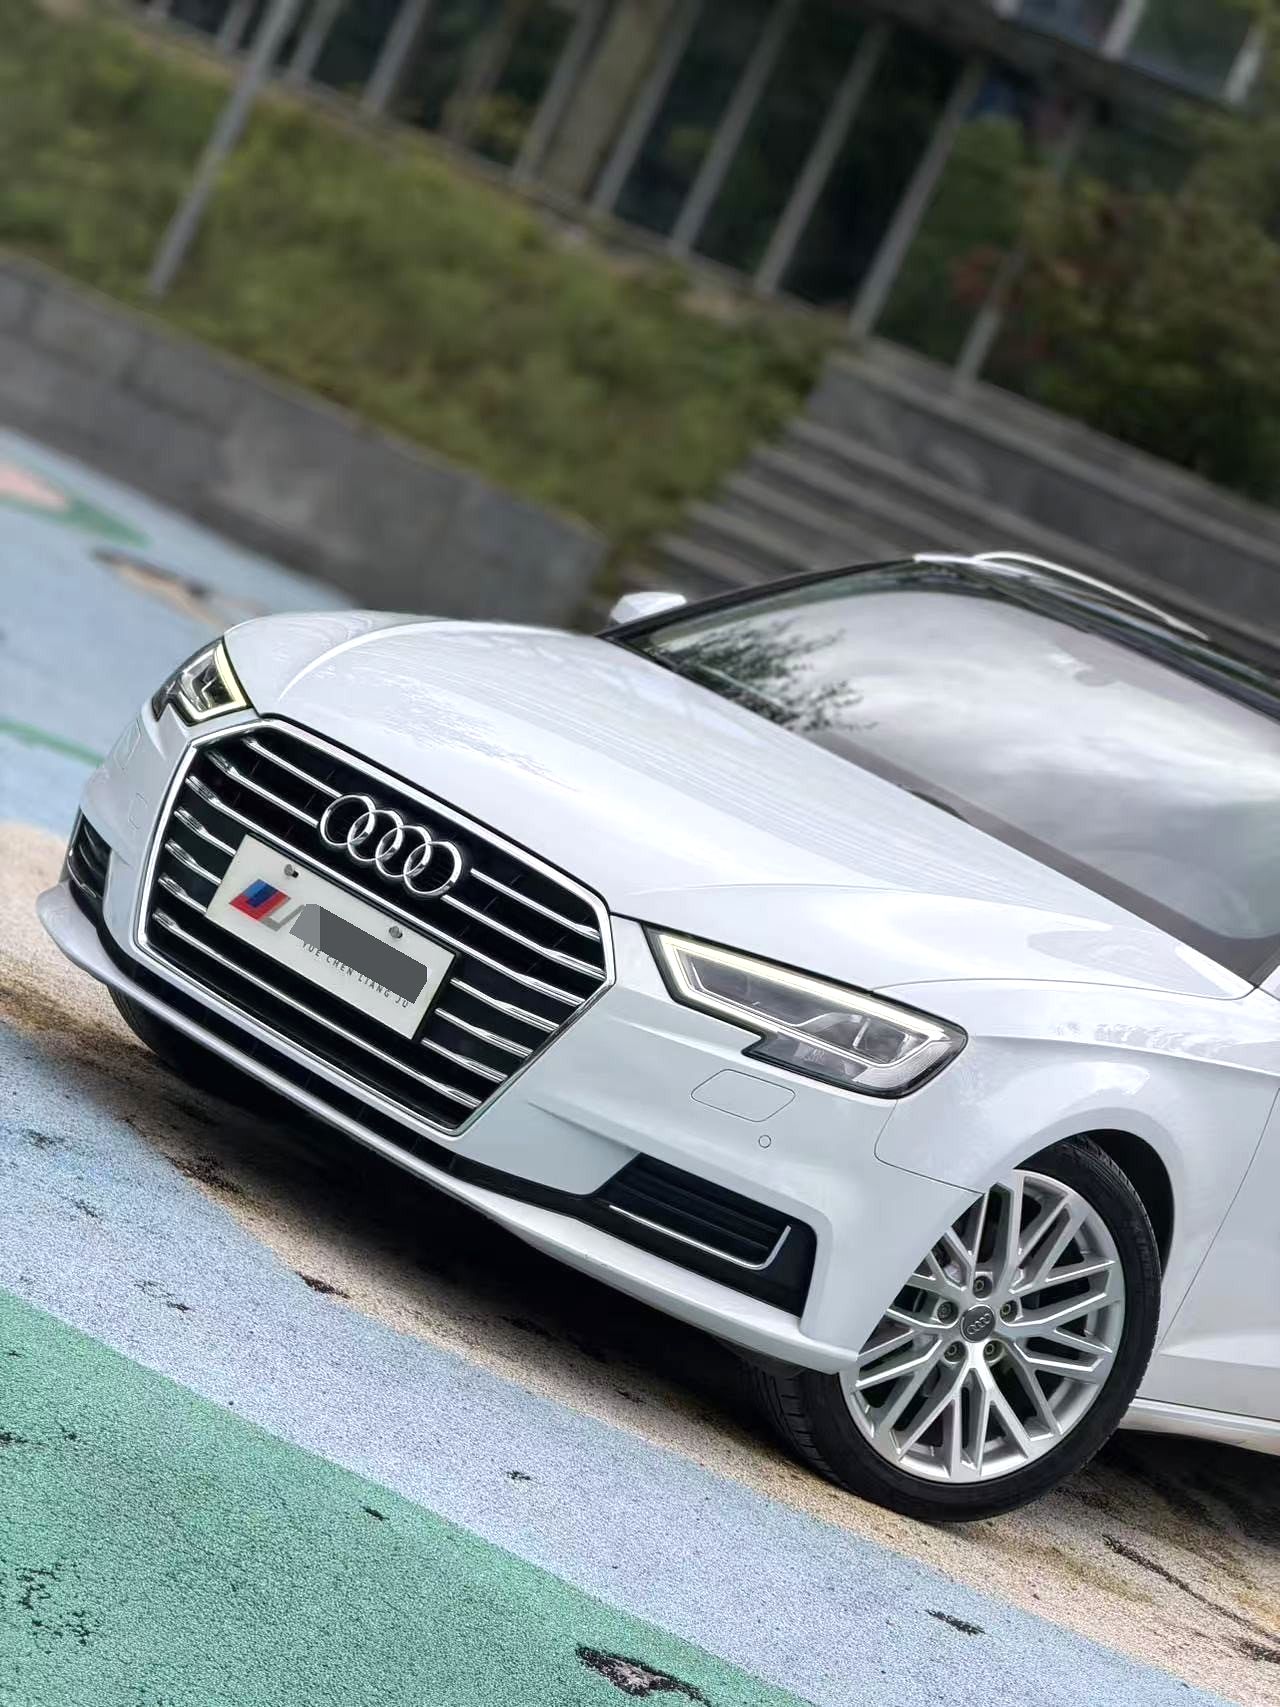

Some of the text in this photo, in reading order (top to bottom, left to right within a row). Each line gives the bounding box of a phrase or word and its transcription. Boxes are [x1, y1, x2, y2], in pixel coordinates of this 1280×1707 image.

[326, 955, 353, 976] CHEN
[358, 974, 390, 998] LIANG
[394, 996, 410, 1008] JU
